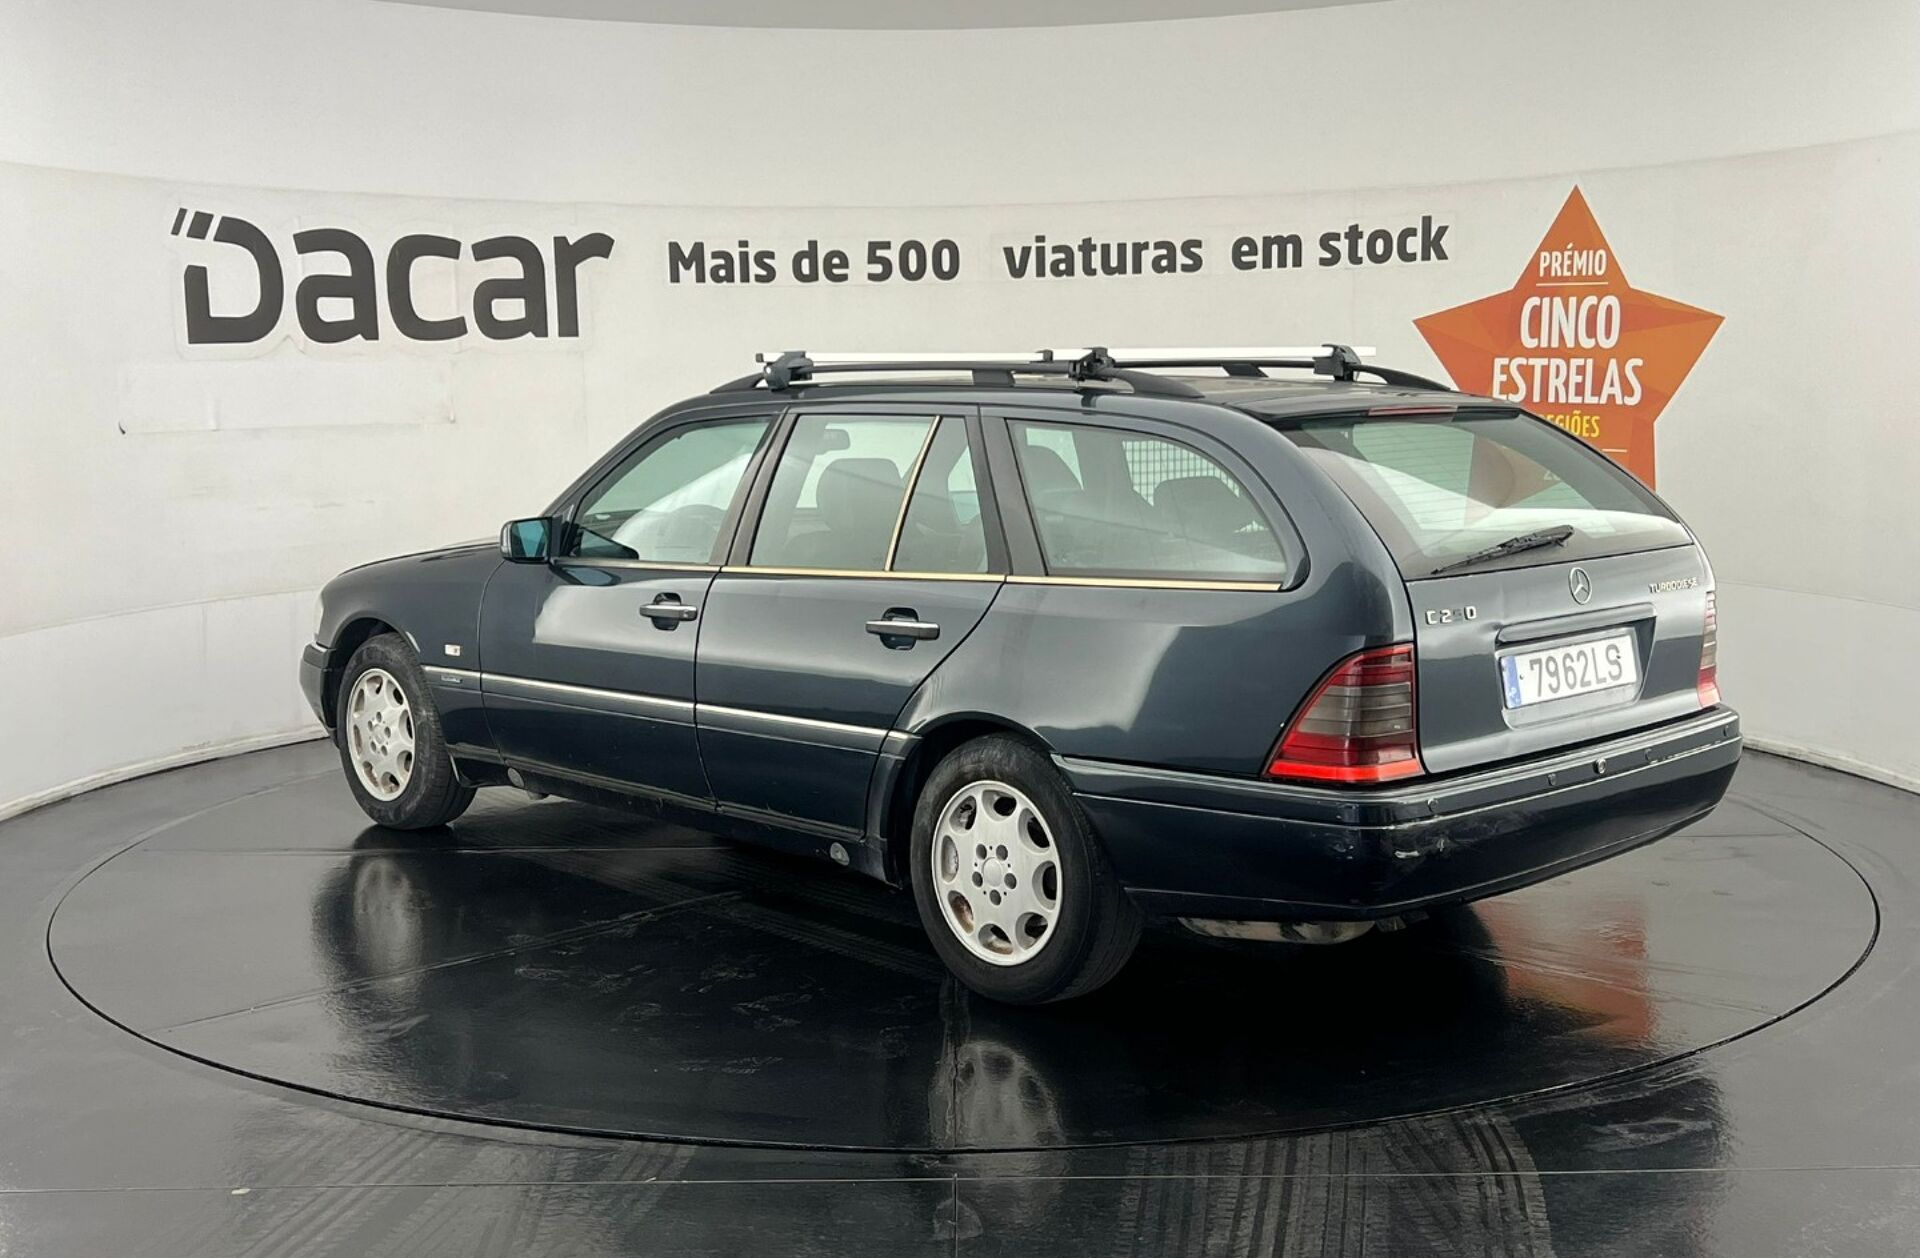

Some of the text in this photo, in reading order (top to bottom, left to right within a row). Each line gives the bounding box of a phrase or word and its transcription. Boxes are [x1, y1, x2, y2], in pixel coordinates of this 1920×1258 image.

[171, 207, 615, 344] Dacar
[668, 215, 1449, 283] Mais de 500 viaturas em stock
[1539, 243, 1607, 277] PRÉMIO
[1519, 295, 1621, 350] CINCO
[1492, 356, 1644, 406] ESTRELAS
[1540, 410, 1600, 437] GIÕES
[1528, 643, 1623, 697] 7962LS
